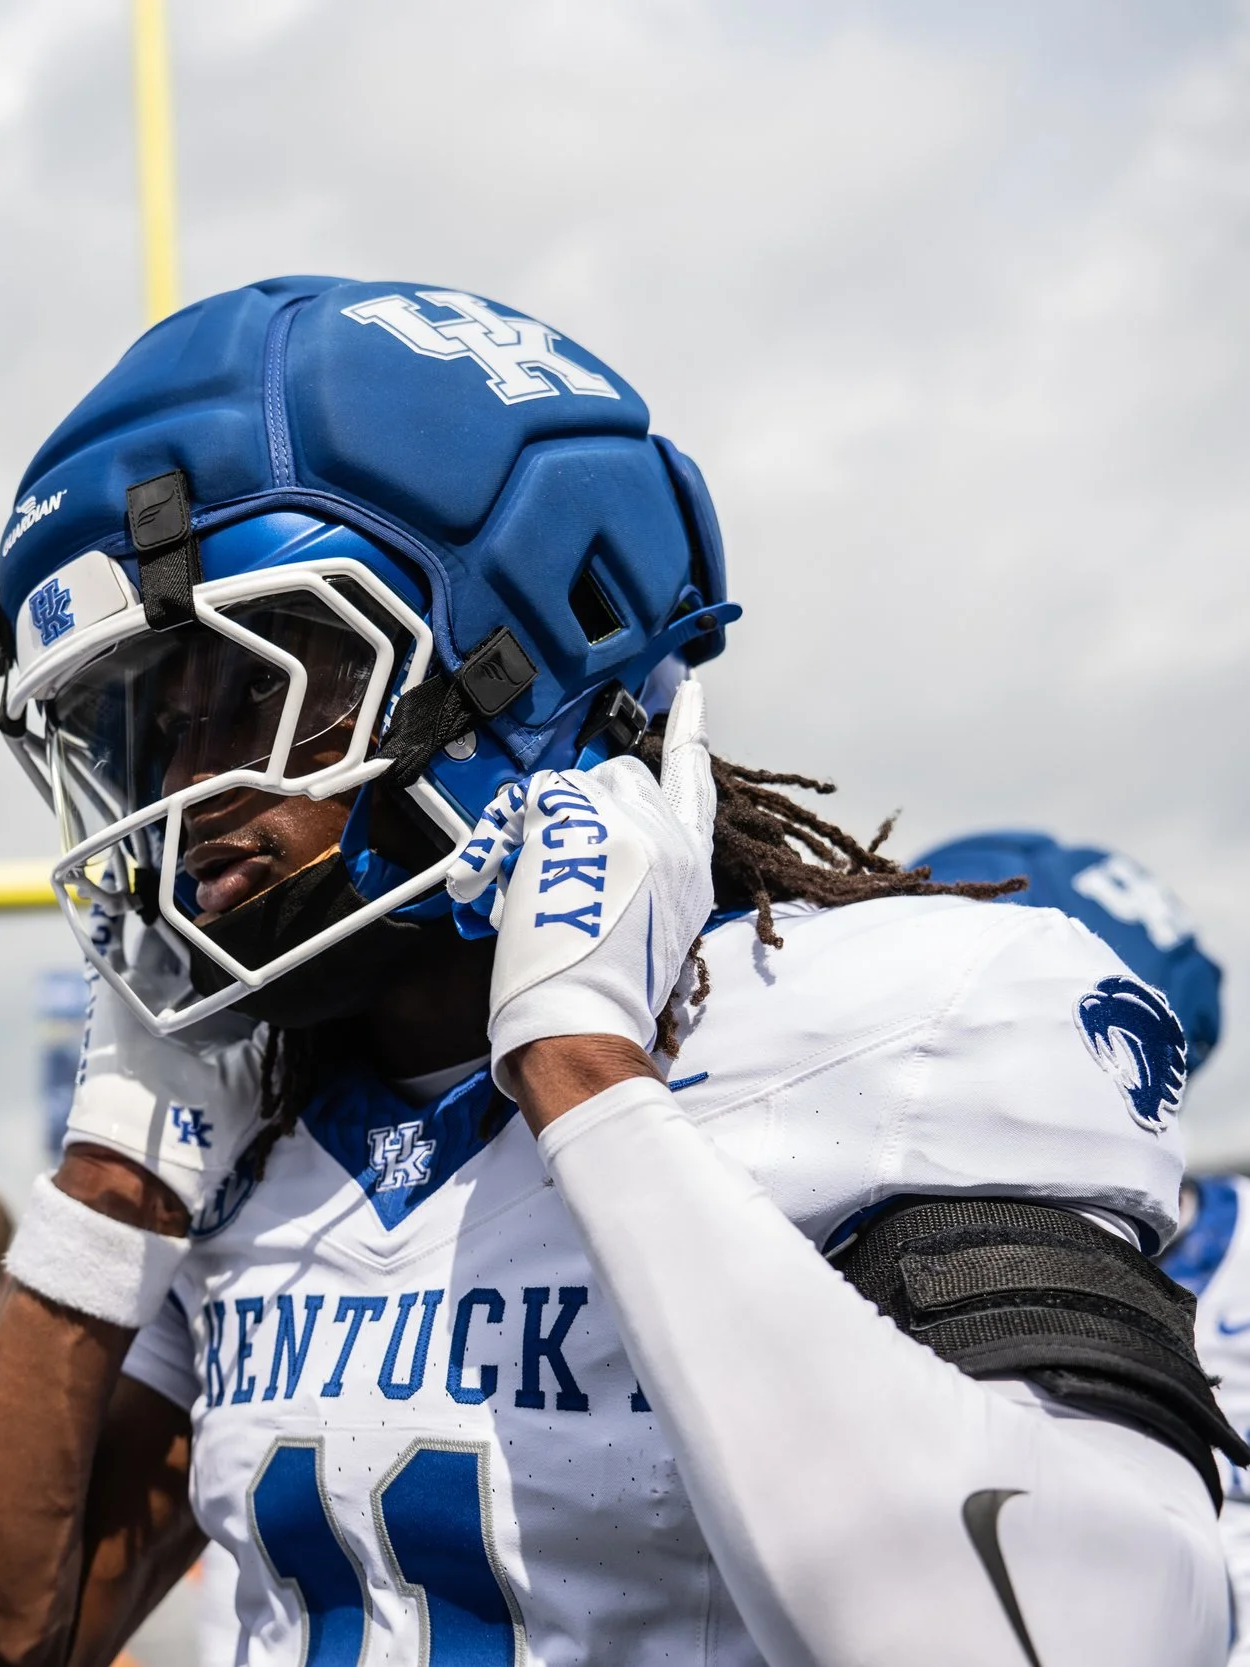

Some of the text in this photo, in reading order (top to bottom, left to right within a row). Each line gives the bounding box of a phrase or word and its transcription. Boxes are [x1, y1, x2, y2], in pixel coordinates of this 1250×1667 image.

[340, 291, 621, 406] UK
[2, 491, 63, 557] GUARDIAN
[29, 578, 75, 646] UK
[171, 1106, 214, 1149] UK
[368, 1120, 436, 1192] UK
[203, 1285, 653, 1412] KENTUCK
[245, 1435, 527, 1667] 11
